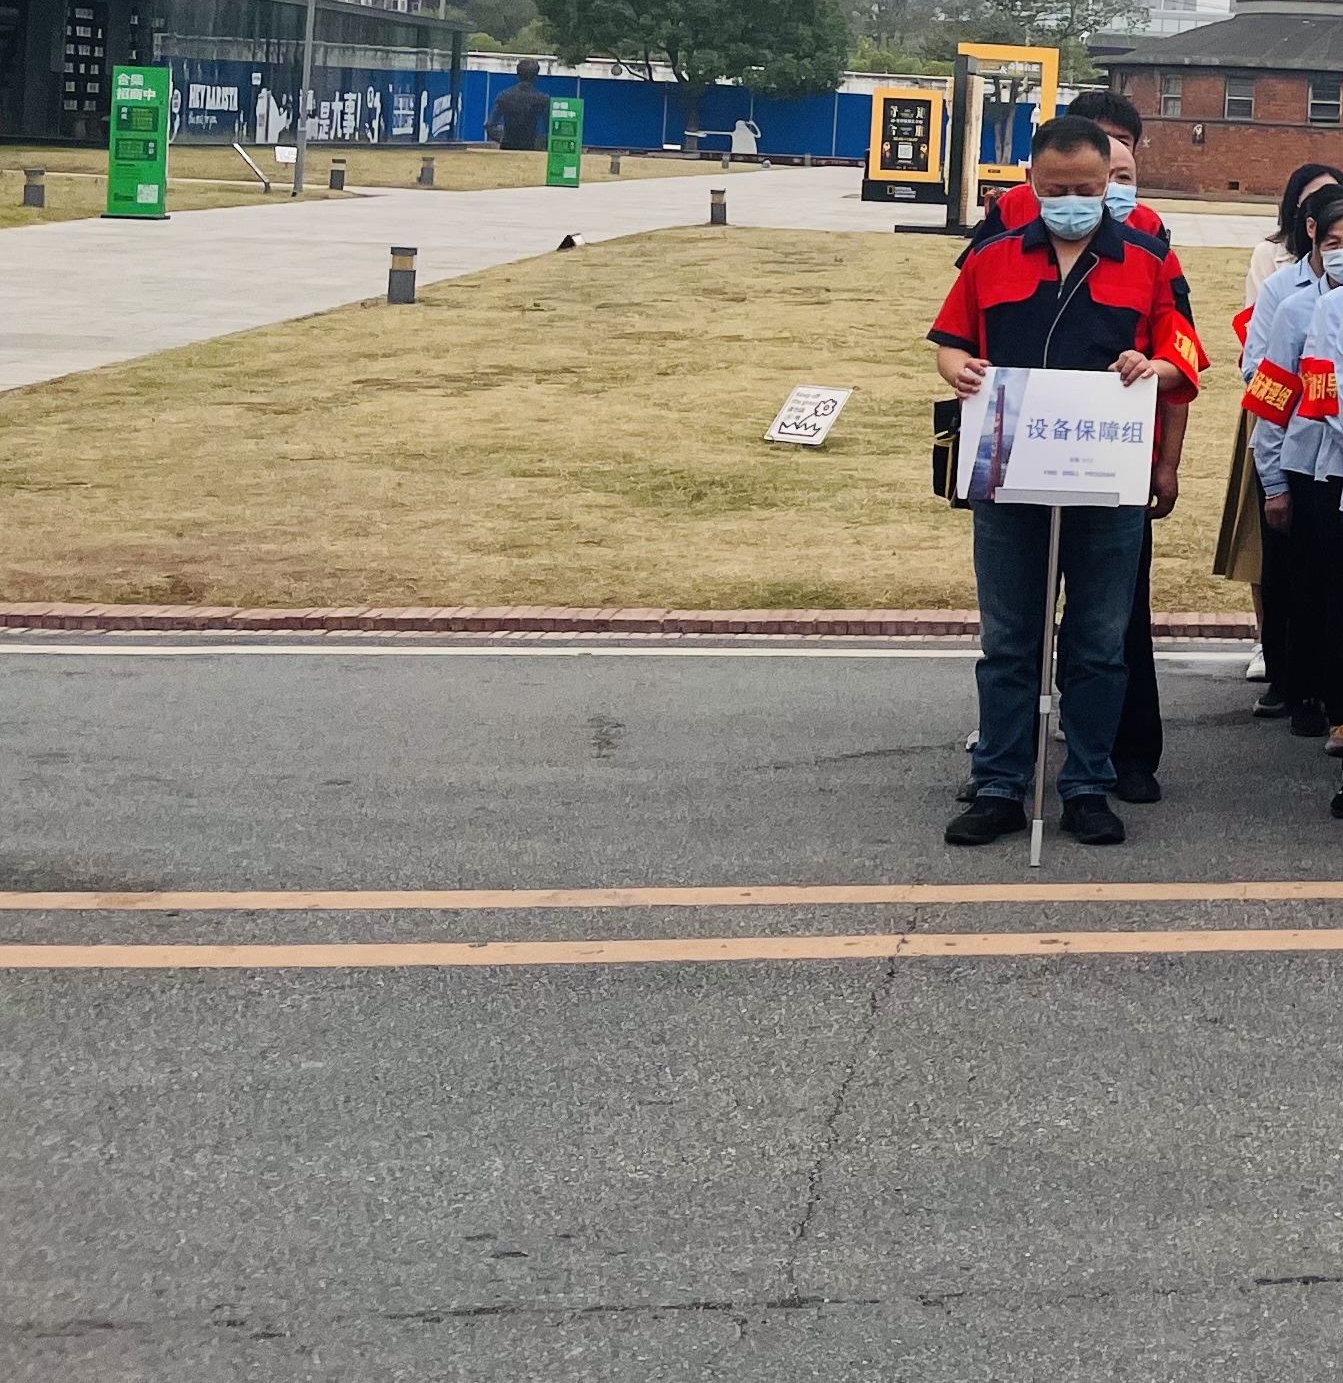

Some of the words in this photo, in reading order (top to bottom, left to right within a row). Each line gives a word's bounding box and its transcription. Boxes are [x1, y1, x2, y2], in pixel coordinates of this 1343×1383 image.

[1026, 418, 1144, 444] 设备保障组
